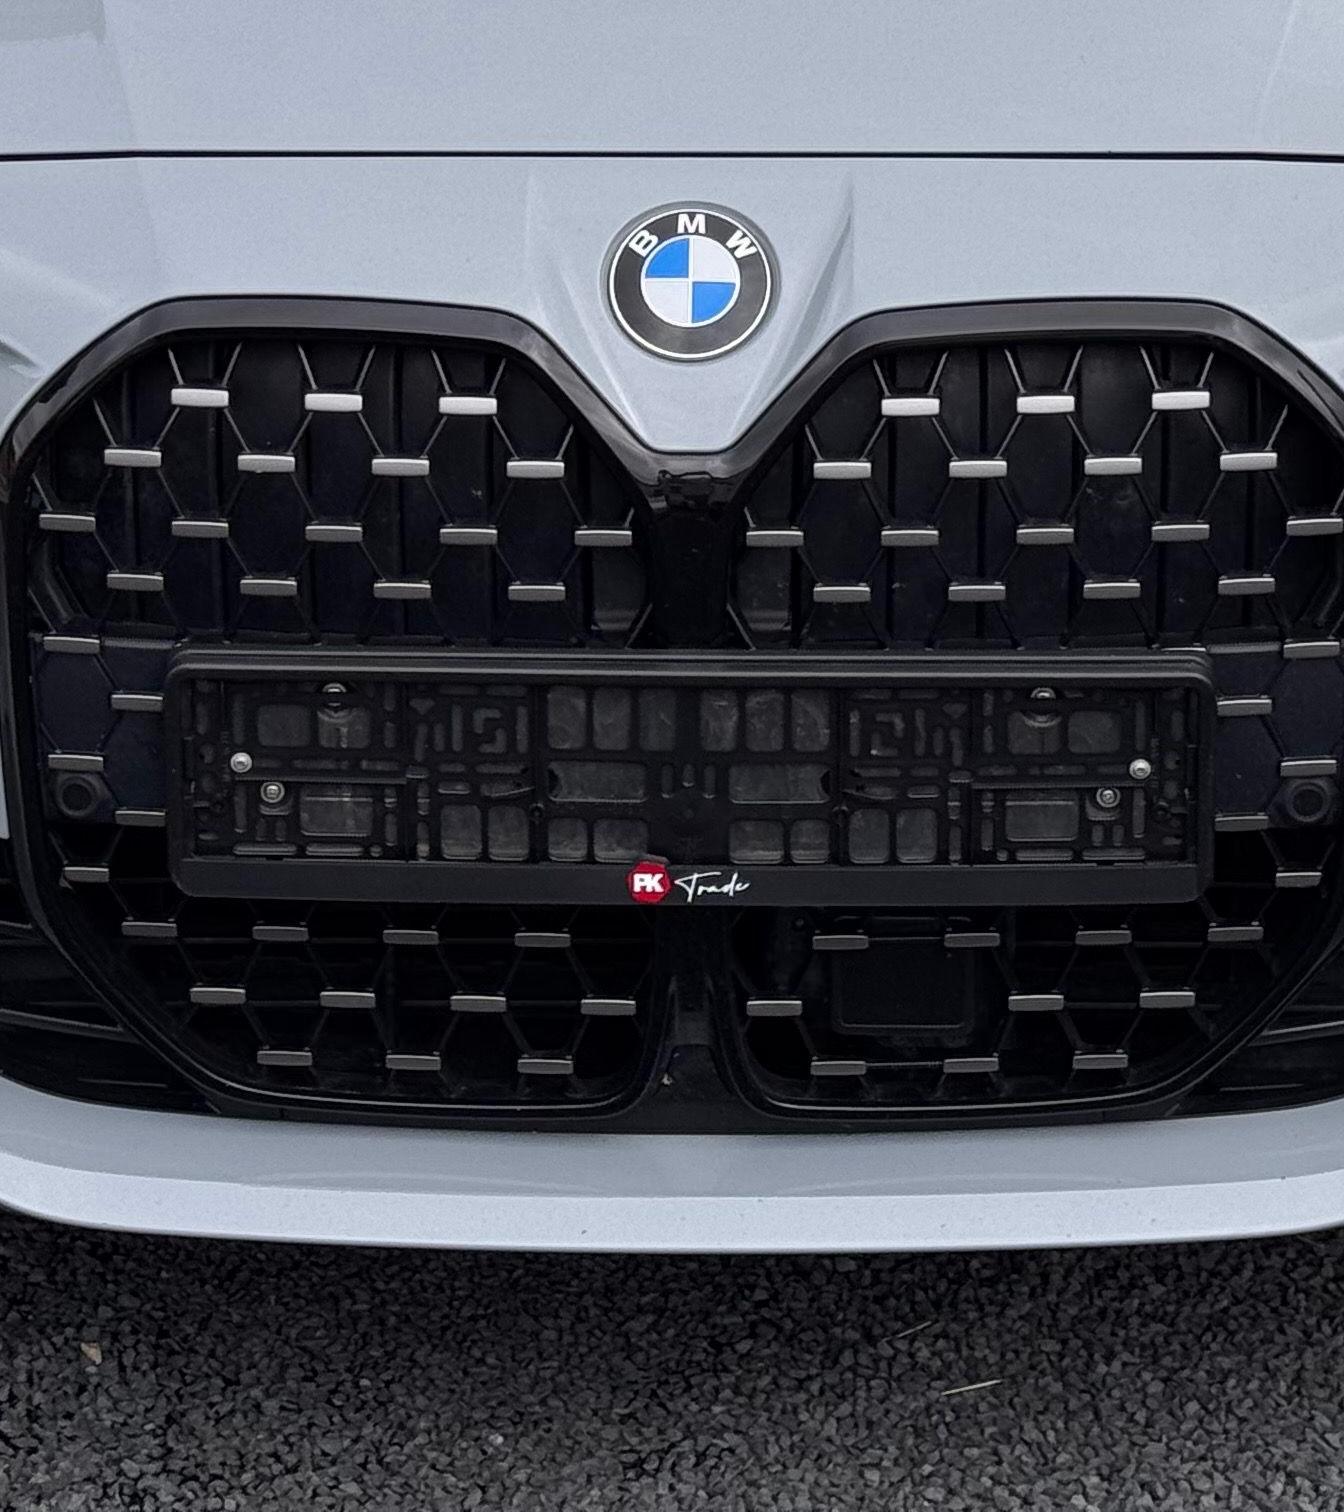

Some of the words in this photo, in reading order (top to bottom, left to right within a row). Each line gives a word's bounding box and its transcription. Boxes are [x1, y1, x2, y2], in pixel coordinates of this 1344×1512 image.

[628, 213, 758, 259] BMW
[632, 873, 665, 893] PK
[673, 871, 751, 903] Trade
